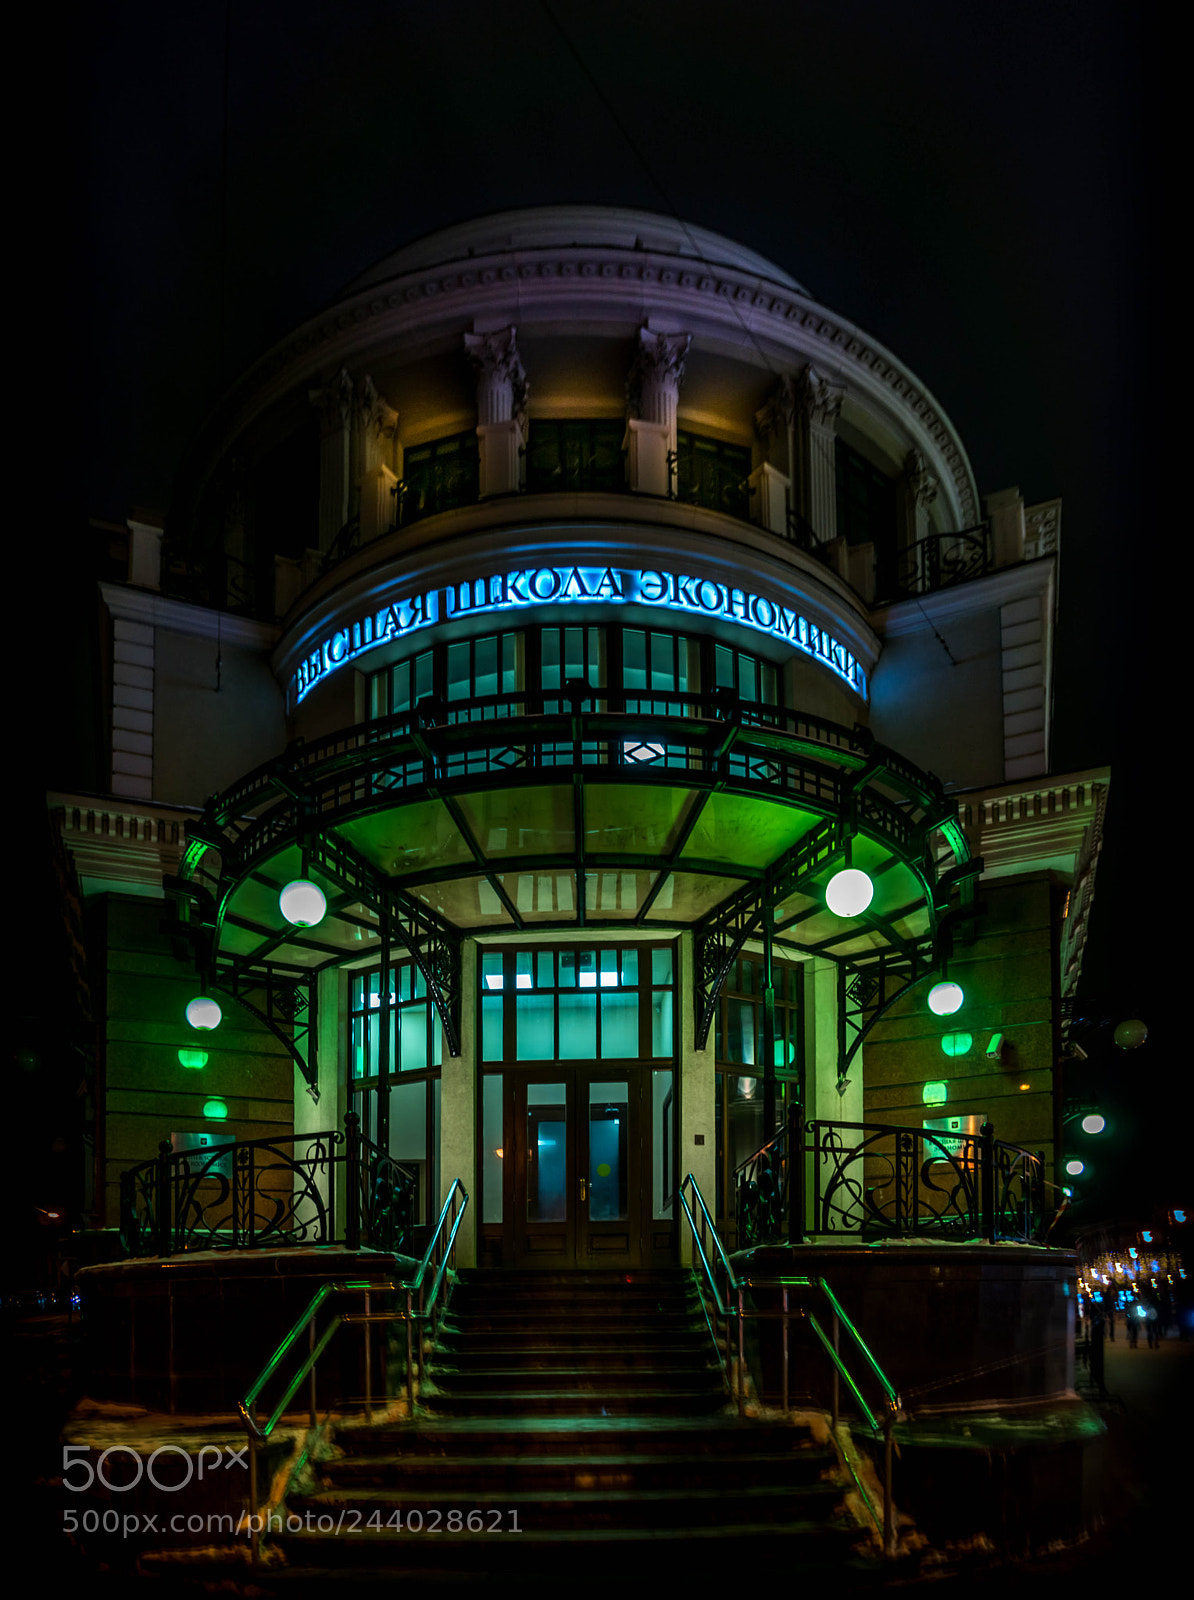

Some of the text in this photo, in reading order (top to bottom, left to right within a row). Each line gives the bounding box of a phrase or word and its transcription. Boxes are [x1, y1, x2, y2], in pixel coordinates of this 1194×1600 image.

[293, 566, 861, 696] ВЫСШАЯ ШКОЛА ЭКОНОМИКИ
